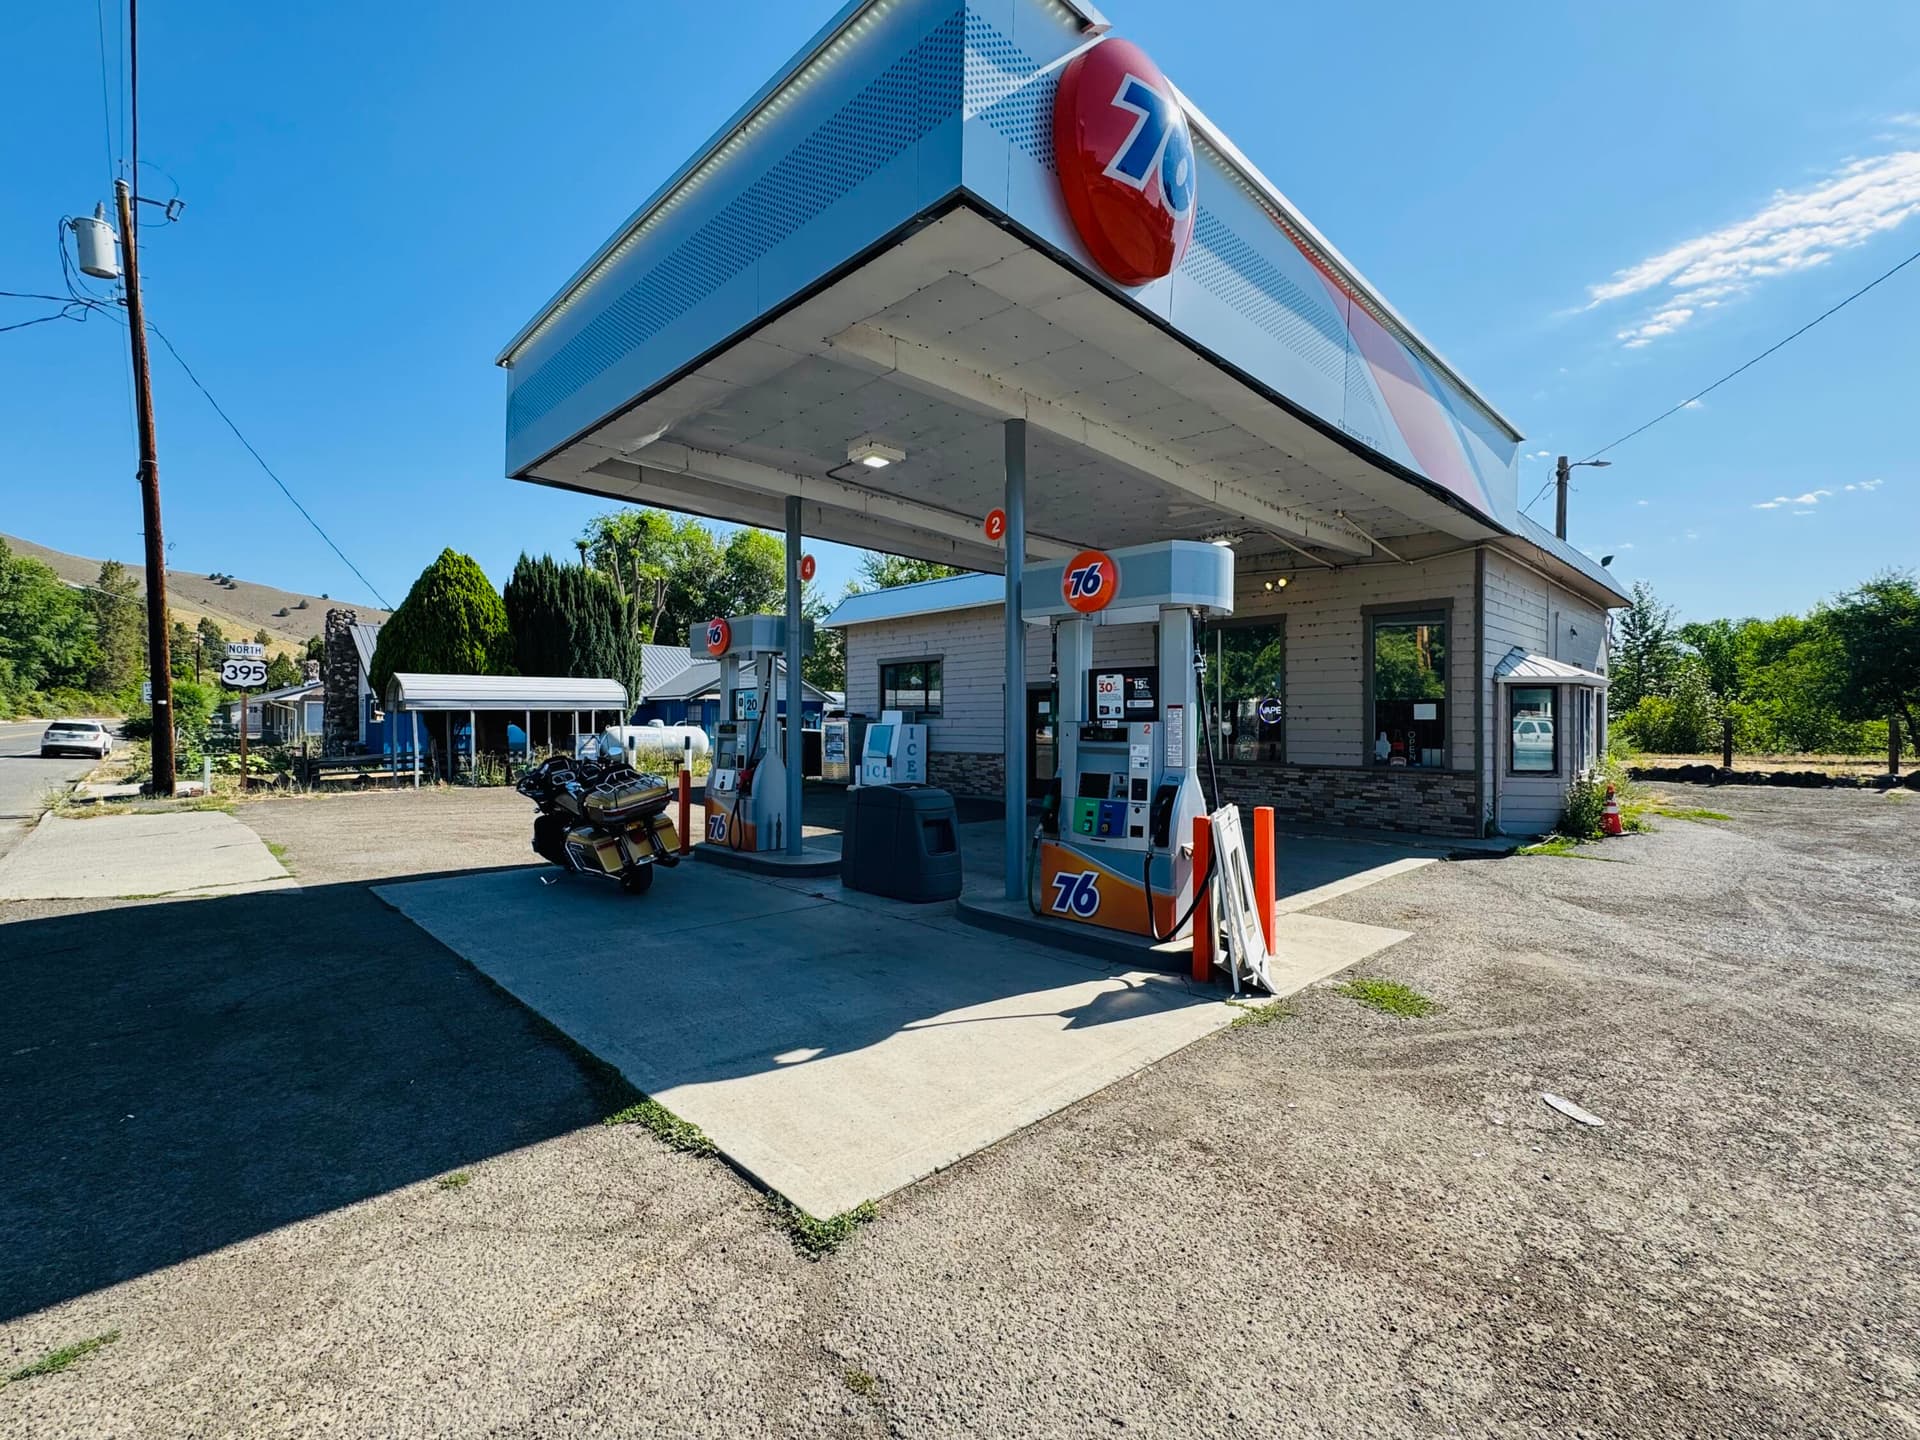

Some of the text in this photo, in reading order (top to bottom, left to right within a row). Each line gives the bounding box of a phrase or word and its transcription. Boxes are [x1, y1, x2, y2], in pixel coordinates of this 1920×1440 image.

[1103, 73, 1197, 221] 76
[991, 516, 1001, 534] 2
[1069, 562, 1103, 599] 76
[707, 624, 723, 648] 76
[228, 644, 262, 655] NORTH
[225, 664, 265, 681] 395
[1262, 706, 1282, 715] VAPE
[1143, 724, 1152, 735] 2
[906, 727, 917, 774] ICE
[709, 813, 727, 841] 76
[1052, 871, 1100, 917] 76
